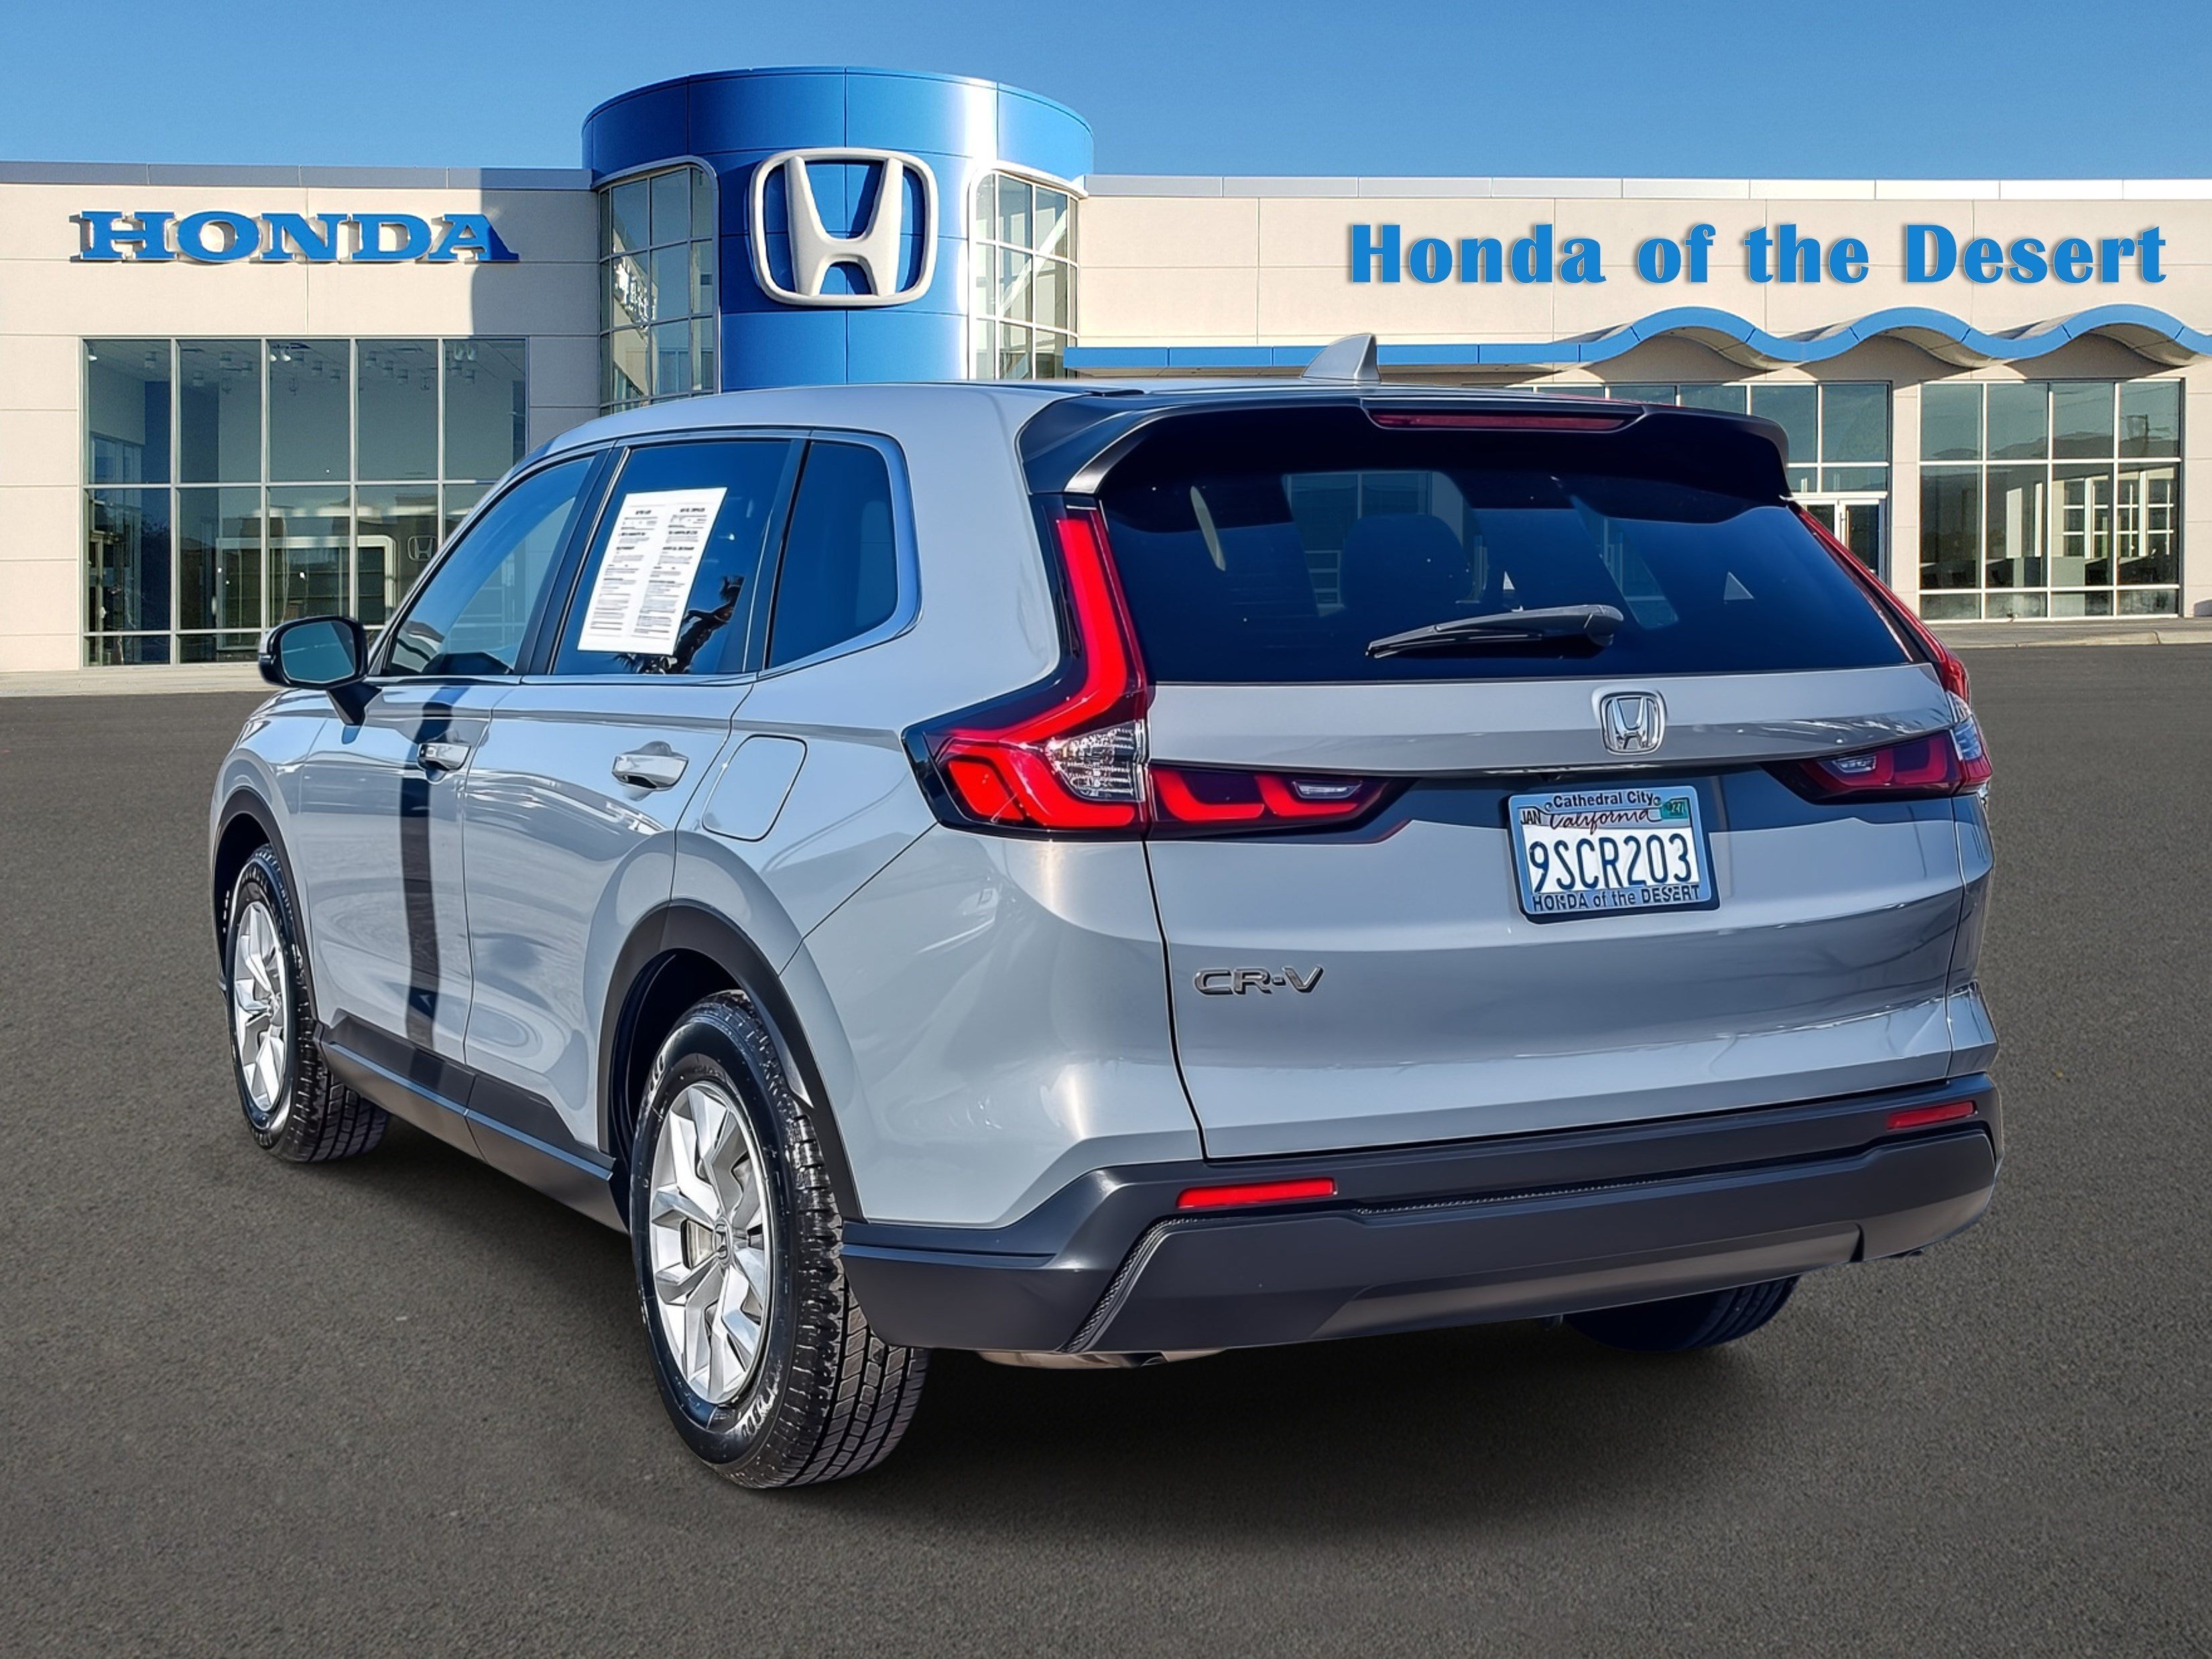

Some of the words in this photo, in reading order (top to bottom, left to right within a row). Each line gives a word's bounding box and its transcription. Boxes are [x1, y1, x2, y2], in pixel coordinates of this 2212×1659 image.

[78, 210, 520, 263] HONDA
[1350, 223, 1607, 284] Honda
[1637, 223, 1717, 284] of
[1743, 223, 1869, 284] the
[1905, 224, 2167, 284] Desert
[1553, 791, 1623, 808] Cathedral
[1626, 790, 1654, 806] City
[1520, 809, 1542, 825] JAN
[1549, 809, 1662, 836] California
[1528, 832, 1692, 894] 9SCR203
[1532, 892, 1589, 912] HONDA
[1592, 891, 1607, 908] of
[1611, 889, 1636, 907] the
[1640, 883, 1700, 904] DESERT
[1194, 964, 1325, 996] CR-V
